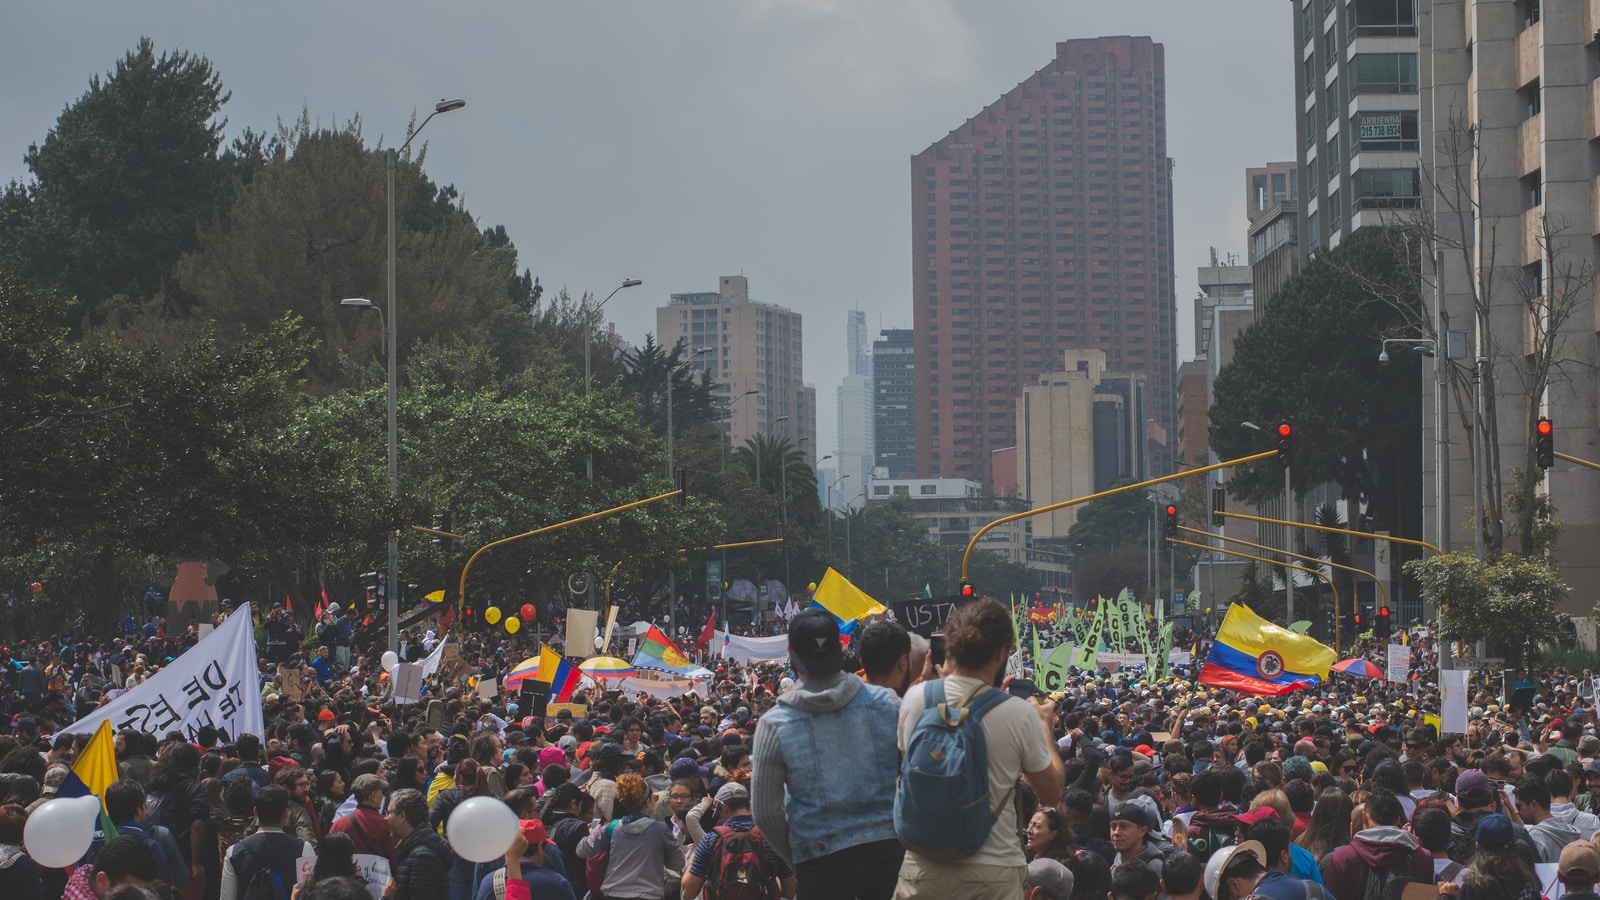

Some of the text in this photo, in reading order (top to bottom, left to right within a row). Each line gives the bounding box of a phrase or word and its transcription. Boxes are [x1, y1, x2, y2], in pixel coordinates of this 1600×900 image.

[1361, 116, 1400, 125] ARRIENDA
[1361, 126, 1373, 137] 315
[1119, 602, 1130, 632] CGT
[1083, 618, 1102, 663] CGT
[1111, 618, 1121, 654] CGT
